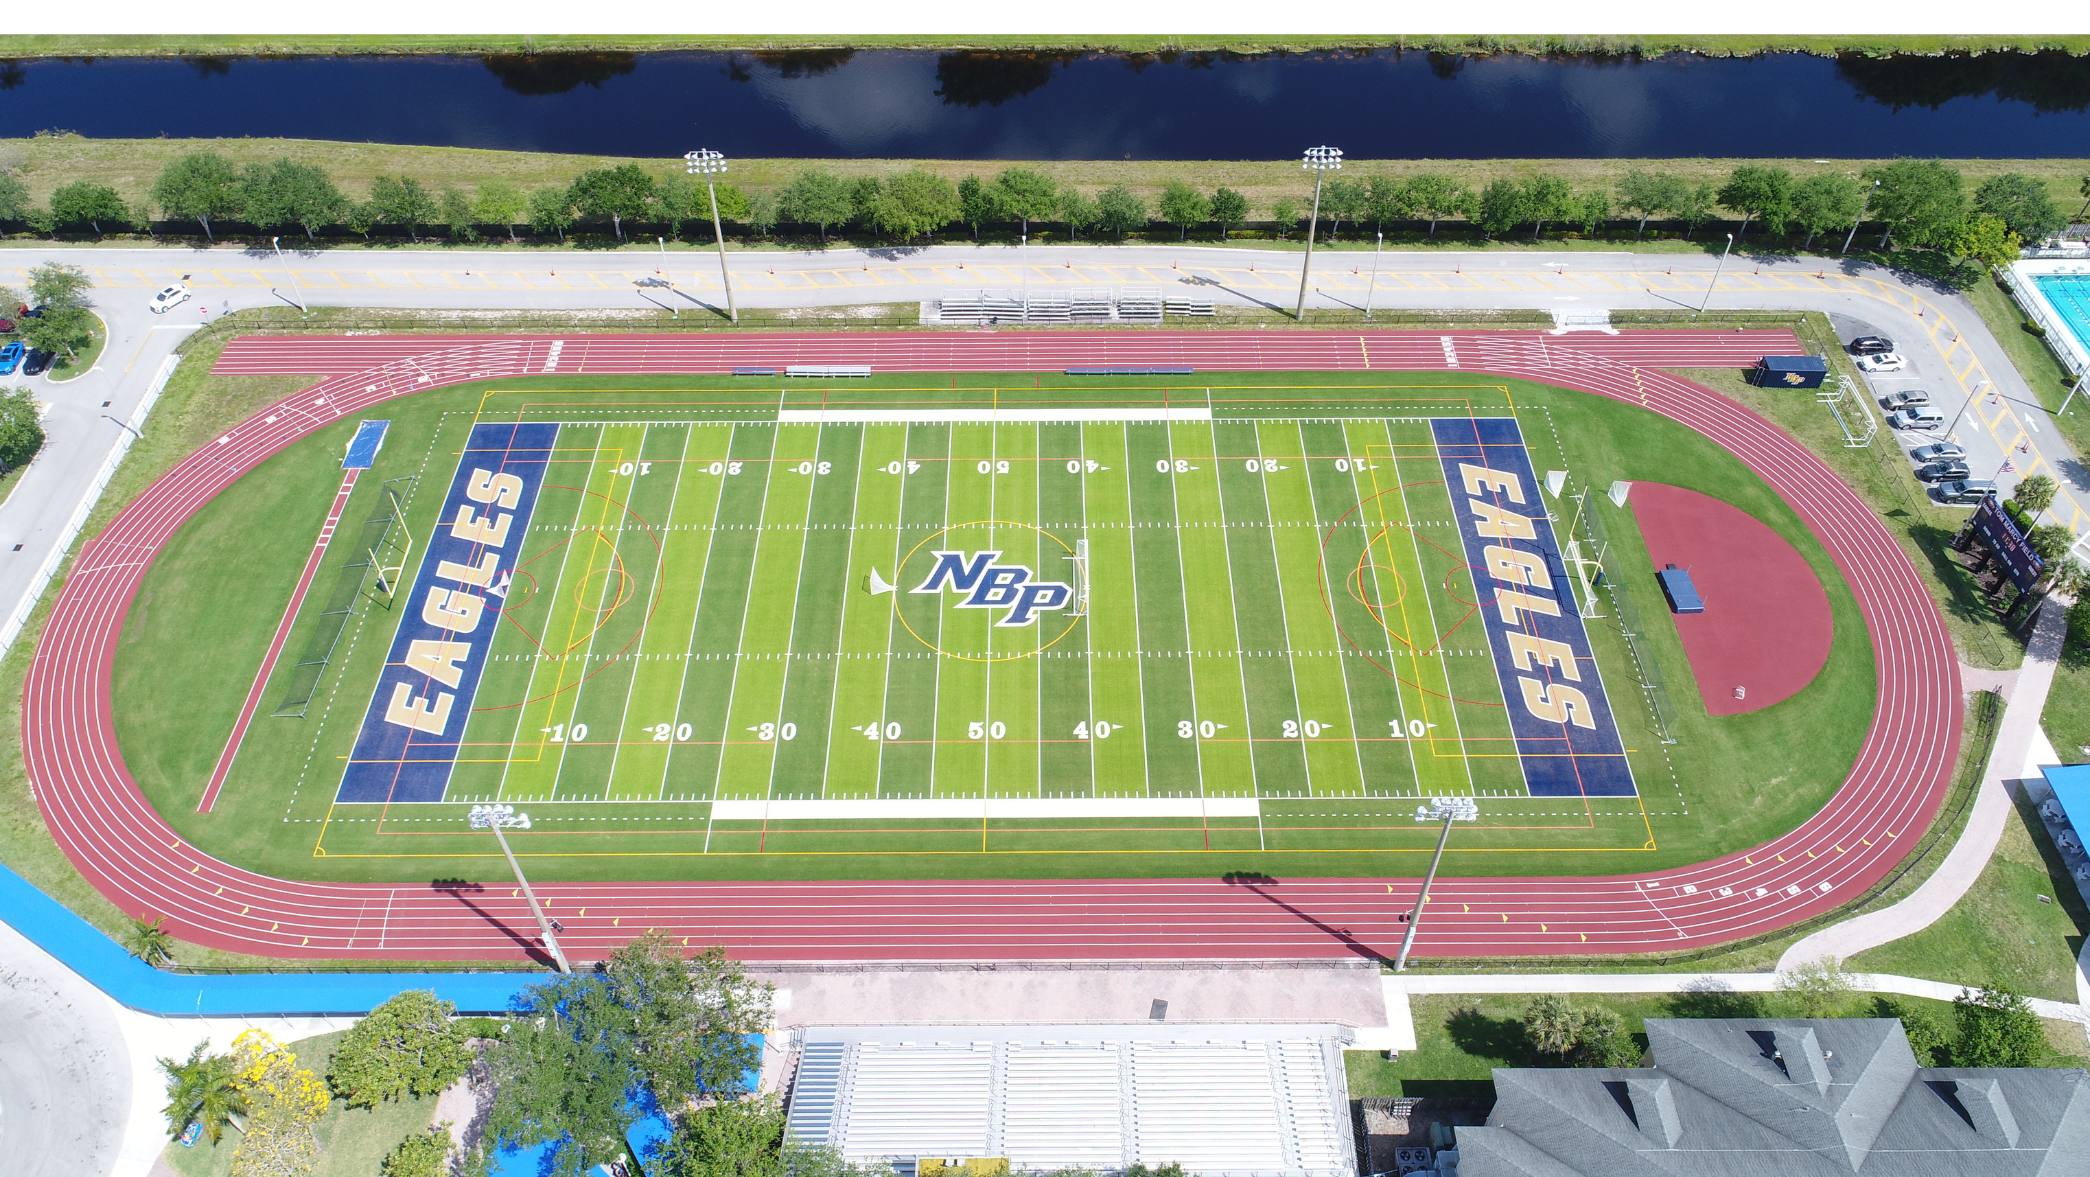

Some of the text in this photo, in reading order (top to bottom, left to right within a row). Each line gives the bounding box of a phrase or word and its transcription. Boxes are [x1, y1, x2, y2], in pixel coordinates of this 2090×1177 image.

[619, 461, 652, 475] 10
[709, 461, 743, 475] 20
[798, 461, 831, 475] 30
[888, 461, 921, 475] 40
[977, 460, 1010, 473] 50
[1067, 460, 1099, 473] 40
[1156, 460, 1189, 473] 30
[1245, 460, 1278, 473] 20
[1335, 460, 1368, 473] 10
[1994, 506, 2005, 522] TOM
[2002, 520, 2021, 544] MARCY
[2018, 540, 2034, 562] FIELD
[908, 551, 1073, 627] NBP
[1458, 462, 1596, 730] EAGLES
[384, 468, 523, 736] EAGLES
[549, 722, 588, 741] 10
[653, 722, 692, 741] 20
[758, 722, 797, 741] 30
[863, 722, 901, 741] 40
[968, 722, 1004, 741] 50
[1073, 720, 1111, 738] 40
[1178, 720, 1215, 738] 30
[1282, 720, 1320, 738] 20
[1388, 720, 1425, 738] 10
